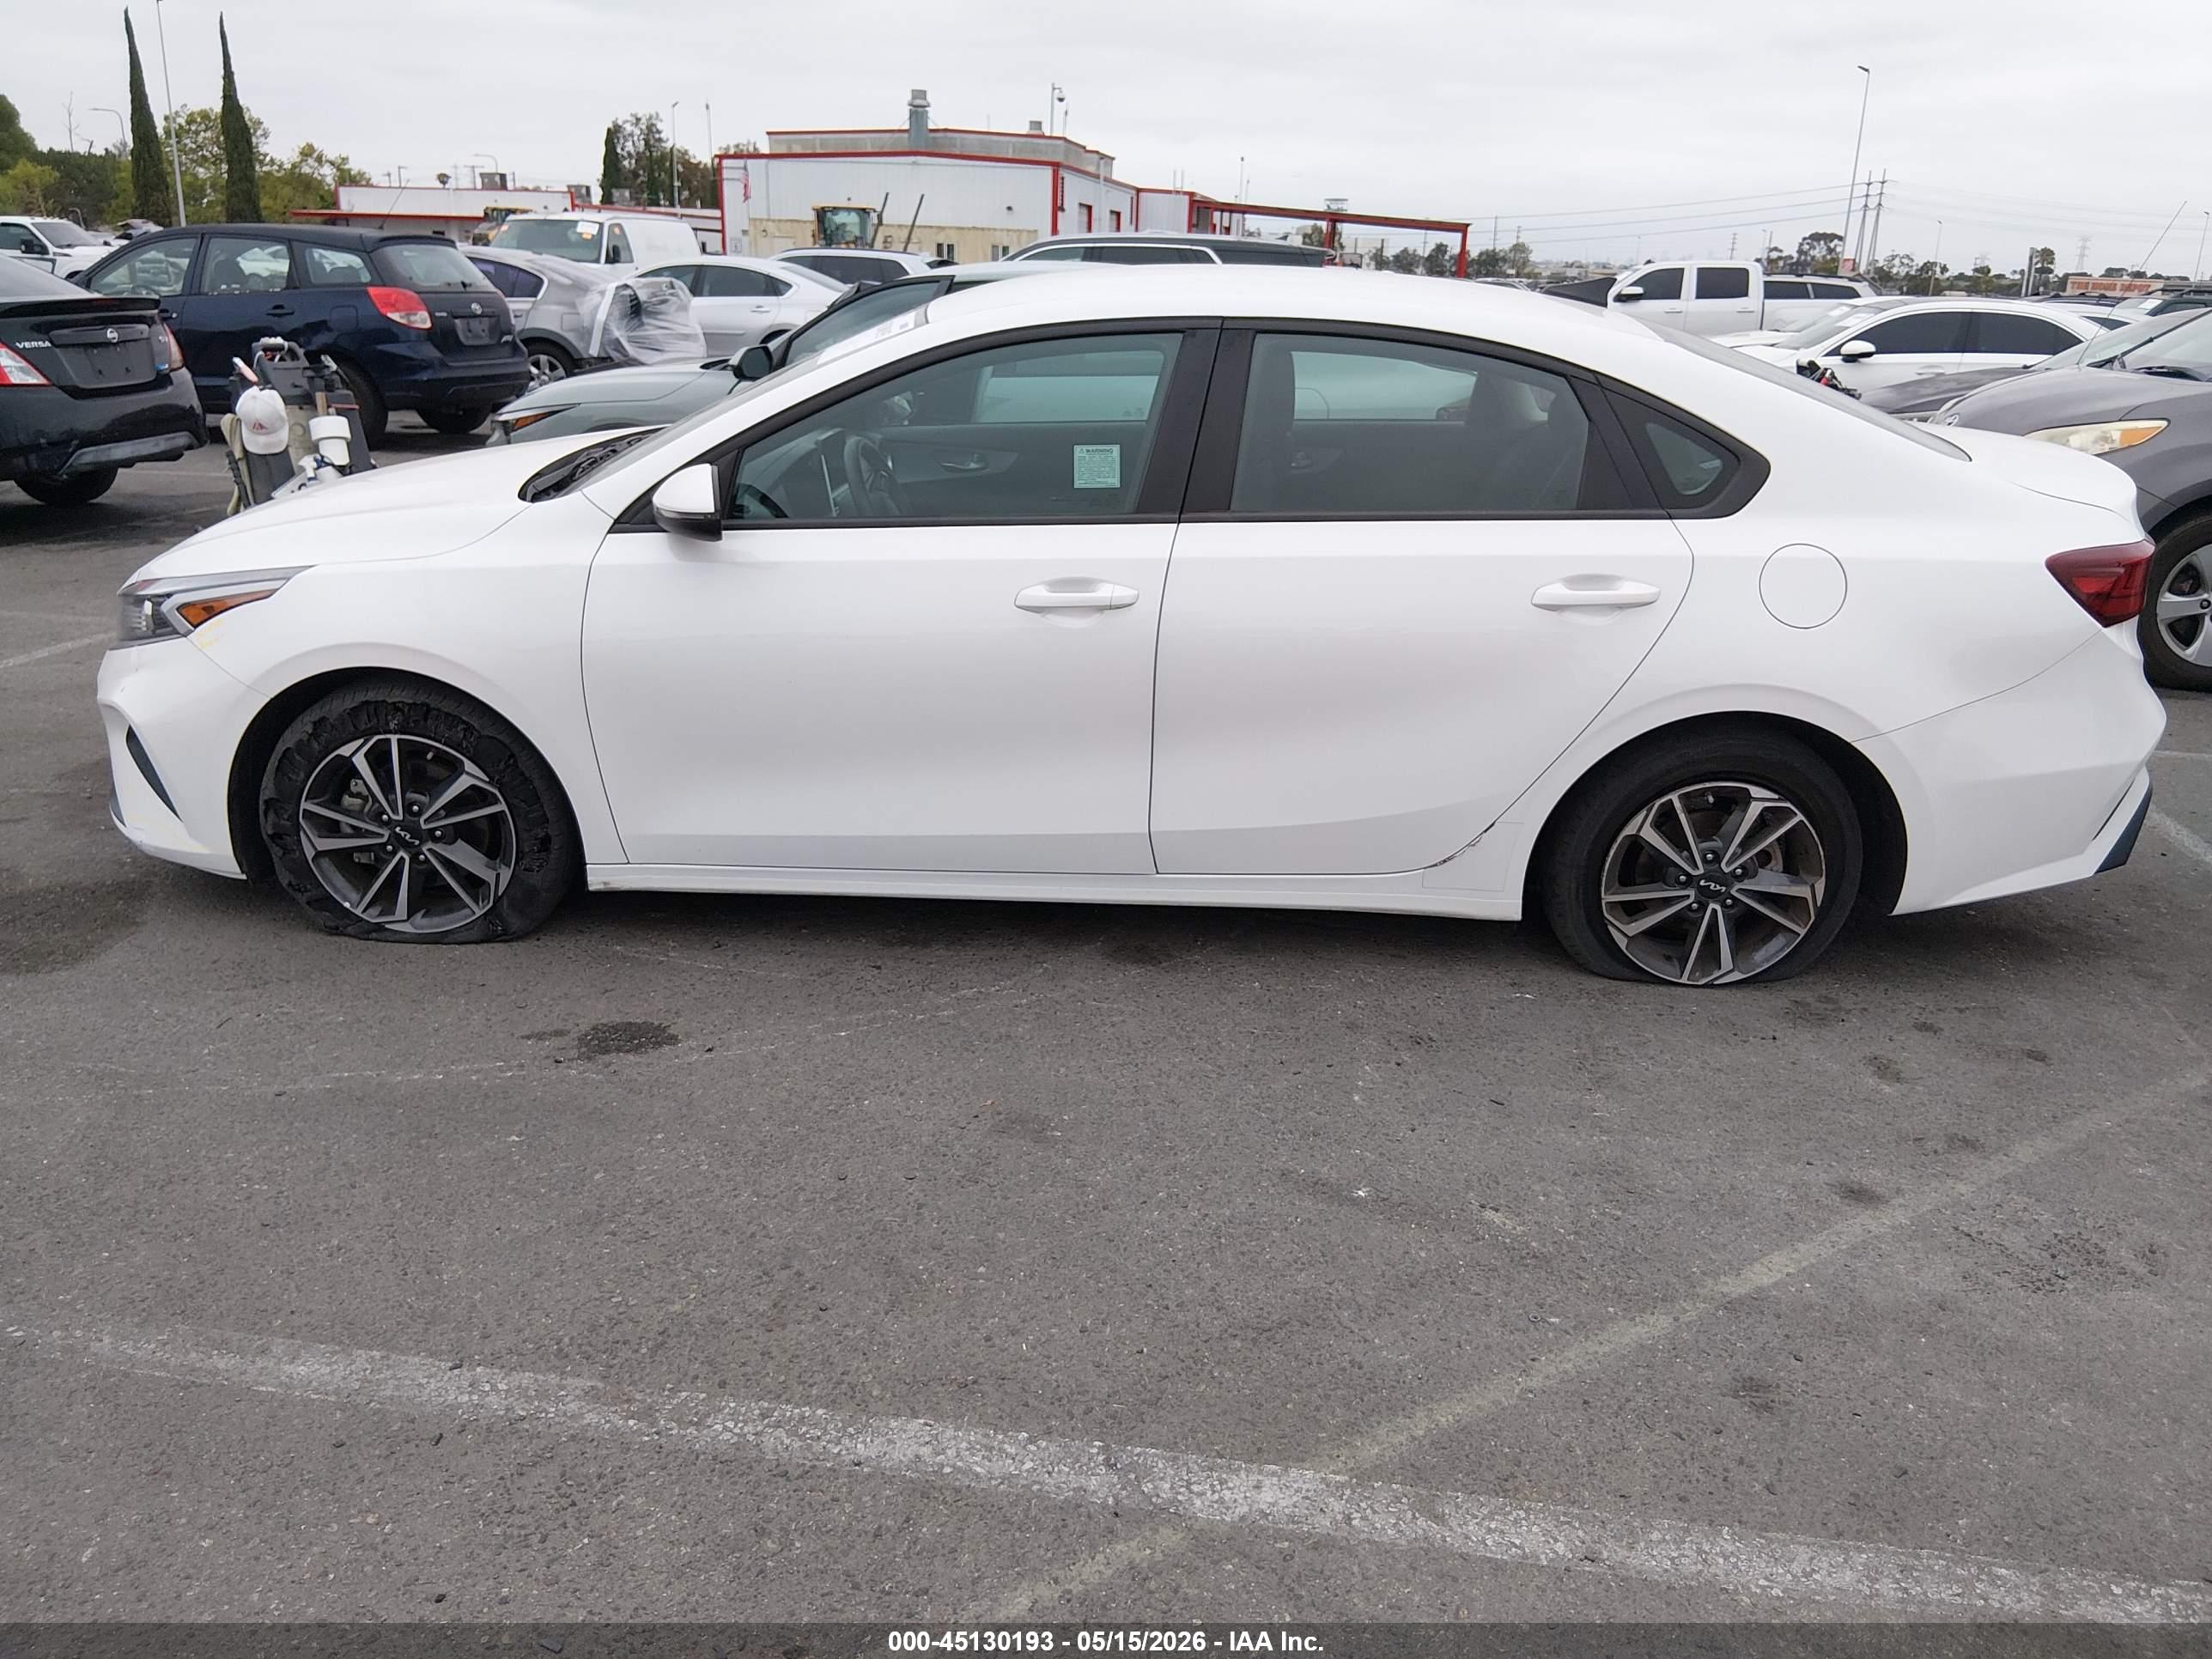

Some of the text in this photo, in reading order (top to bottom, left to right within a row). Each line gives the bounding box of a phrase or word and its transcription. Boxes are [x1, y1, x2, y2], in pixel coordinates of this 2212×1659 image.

[2070, 281, 2089, 290] THE
[2119, 283, 2151, 293] DEPOT
[15, 340, 52, 349] VERSA
